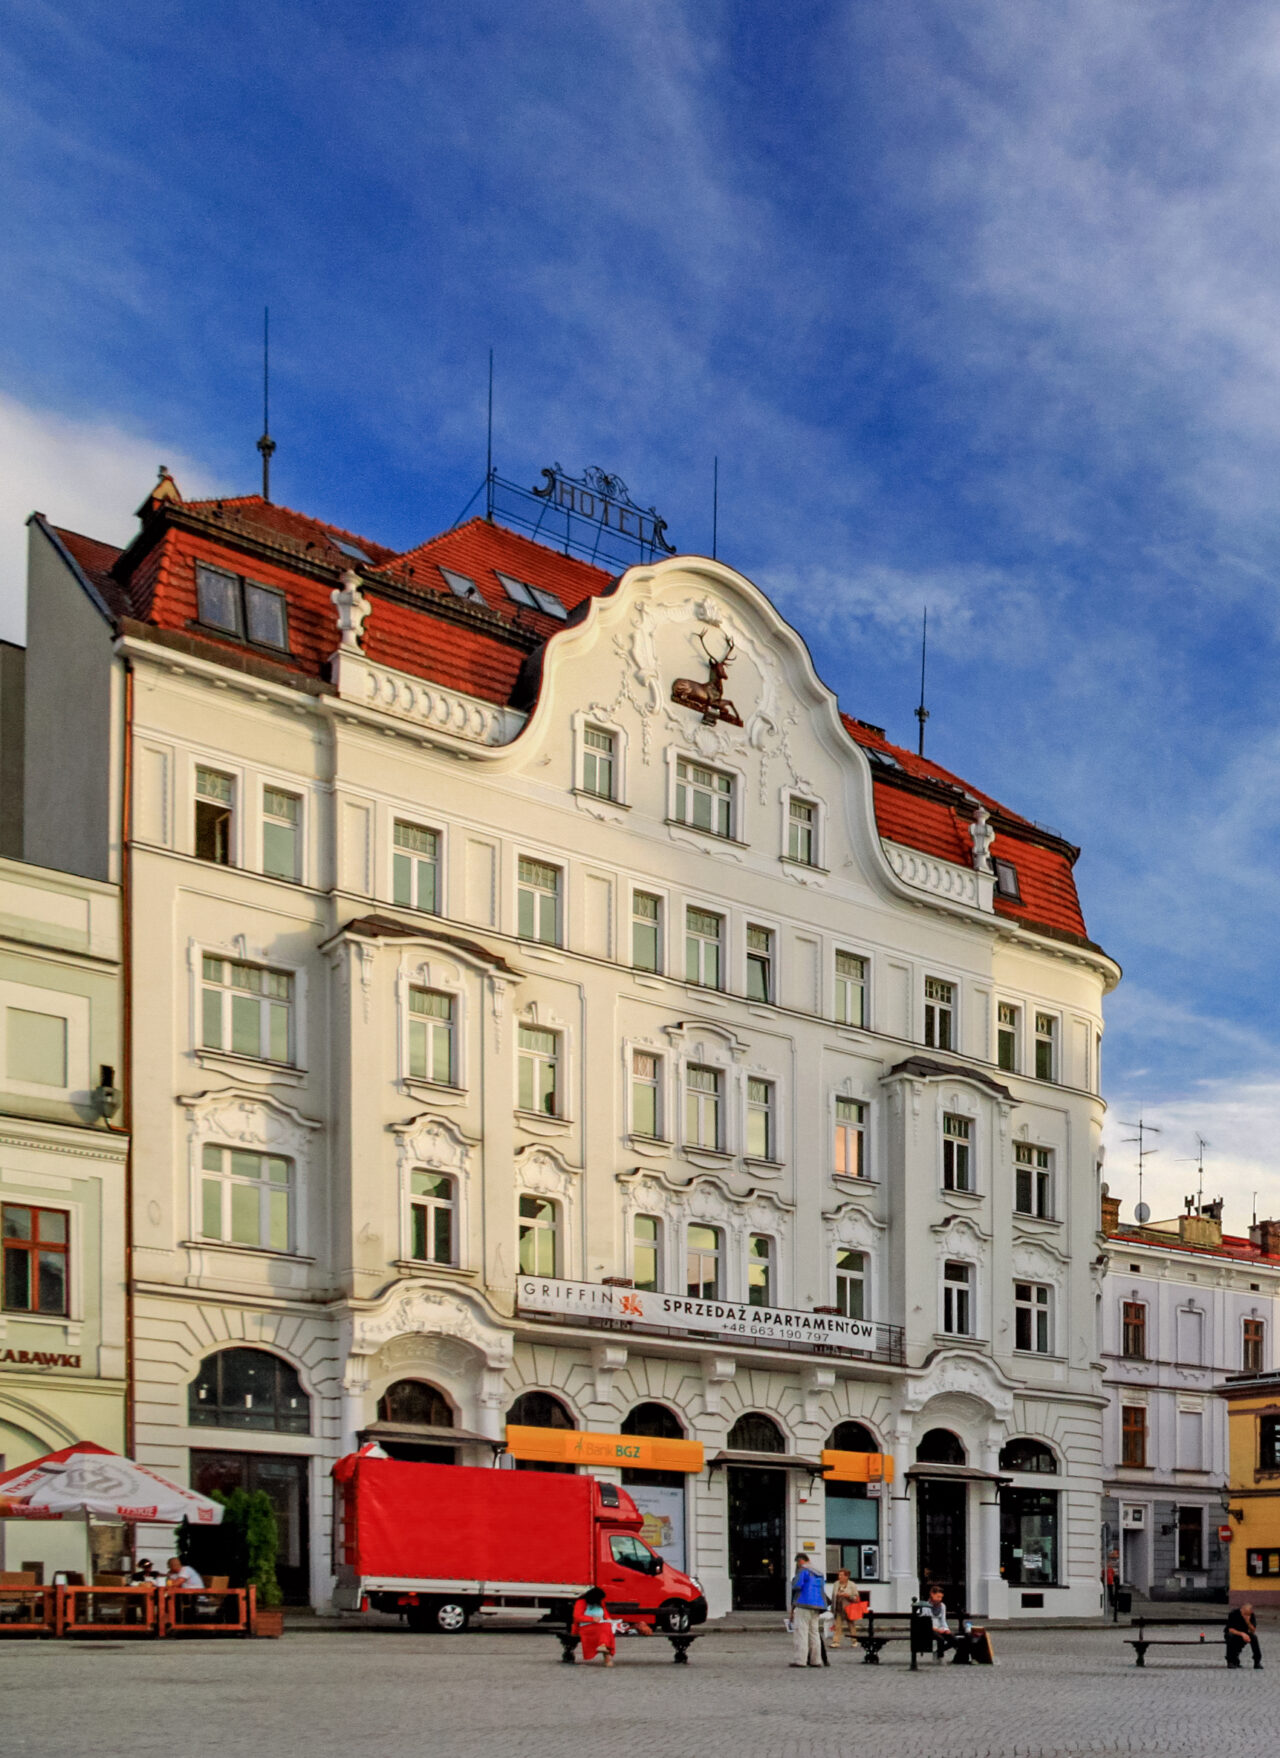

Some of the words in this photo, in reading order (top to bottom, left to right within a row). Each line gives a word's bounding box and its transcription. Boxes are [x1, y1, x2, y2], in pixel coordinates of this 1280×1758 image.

[560, 481, 653, 543] HOTEL
[524, 1283, 613, 1303] GRIFFIN
[664, 1300, 747, 1321] SPRZEDAŻ
[752, 1311, 873, 1337] APARTAMENTÓW
[722, 1323, 746, 1333] +48
[750, 1326, 774, 1336] 663
[779, 1329, 801, 1339] 190
[806, 1332, 829, 1342] 797
